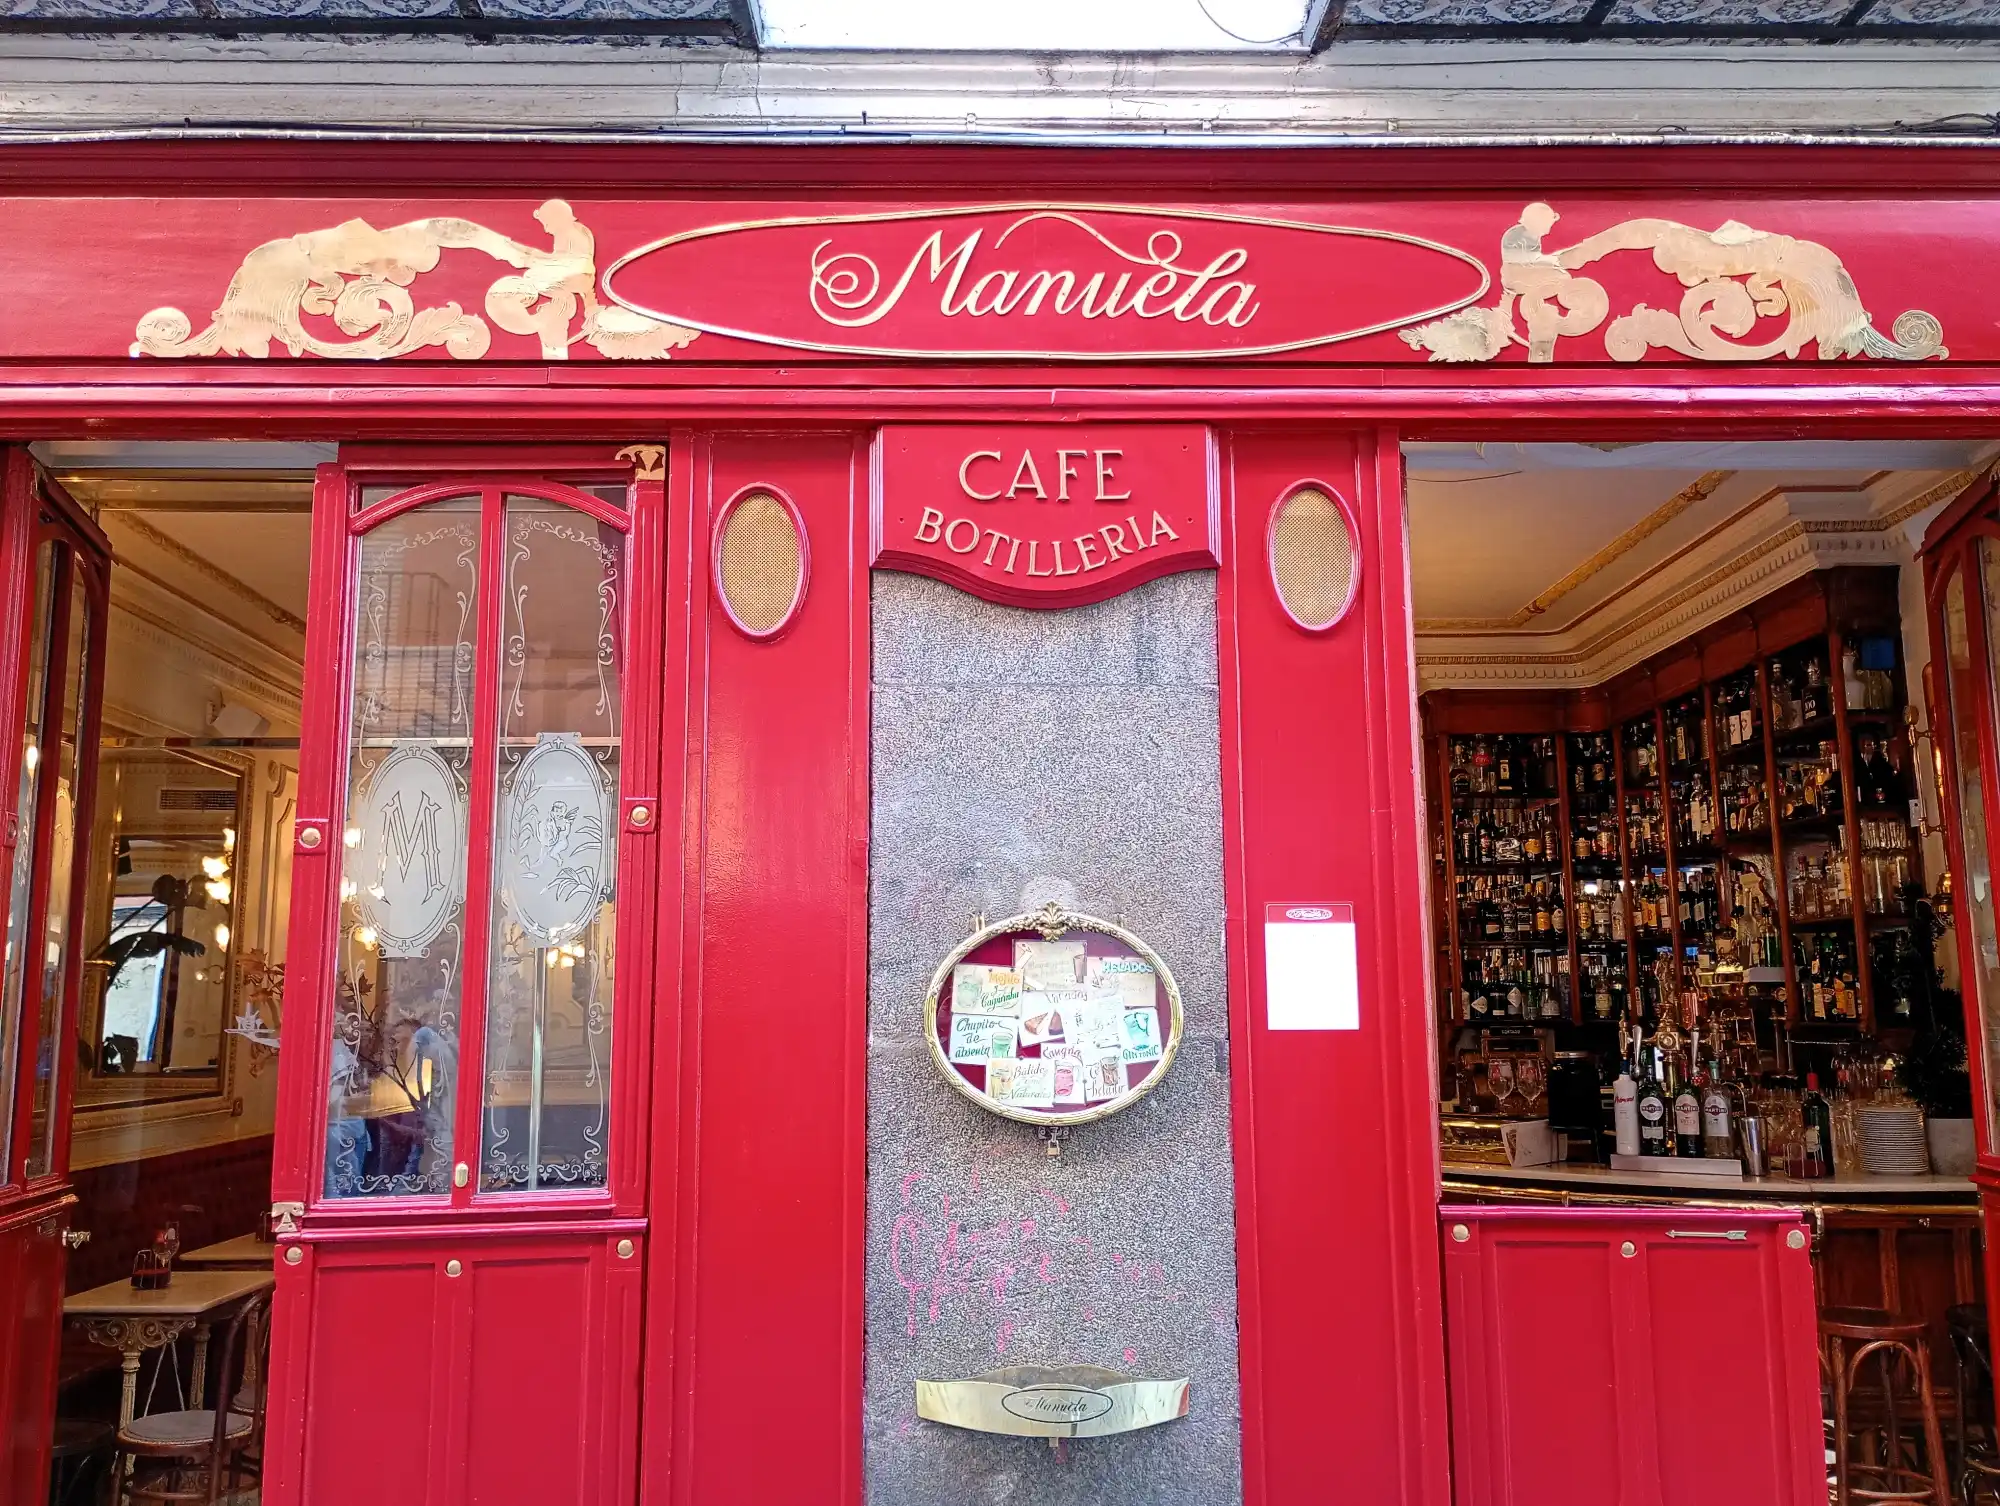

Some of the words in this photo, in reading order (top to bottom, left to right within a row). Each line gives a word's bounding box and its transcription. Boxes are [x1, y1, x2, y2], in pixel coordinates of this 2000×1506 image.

[808, 212, 1259, 328] Manuela
[958, 449, 1131, 502] CAFE
[914, 506, 1179, 577] BOTILLERIA
[1102, 961, 1154, 974] HELADOS
[1025, 1396, 1088, 1412] Manuela
